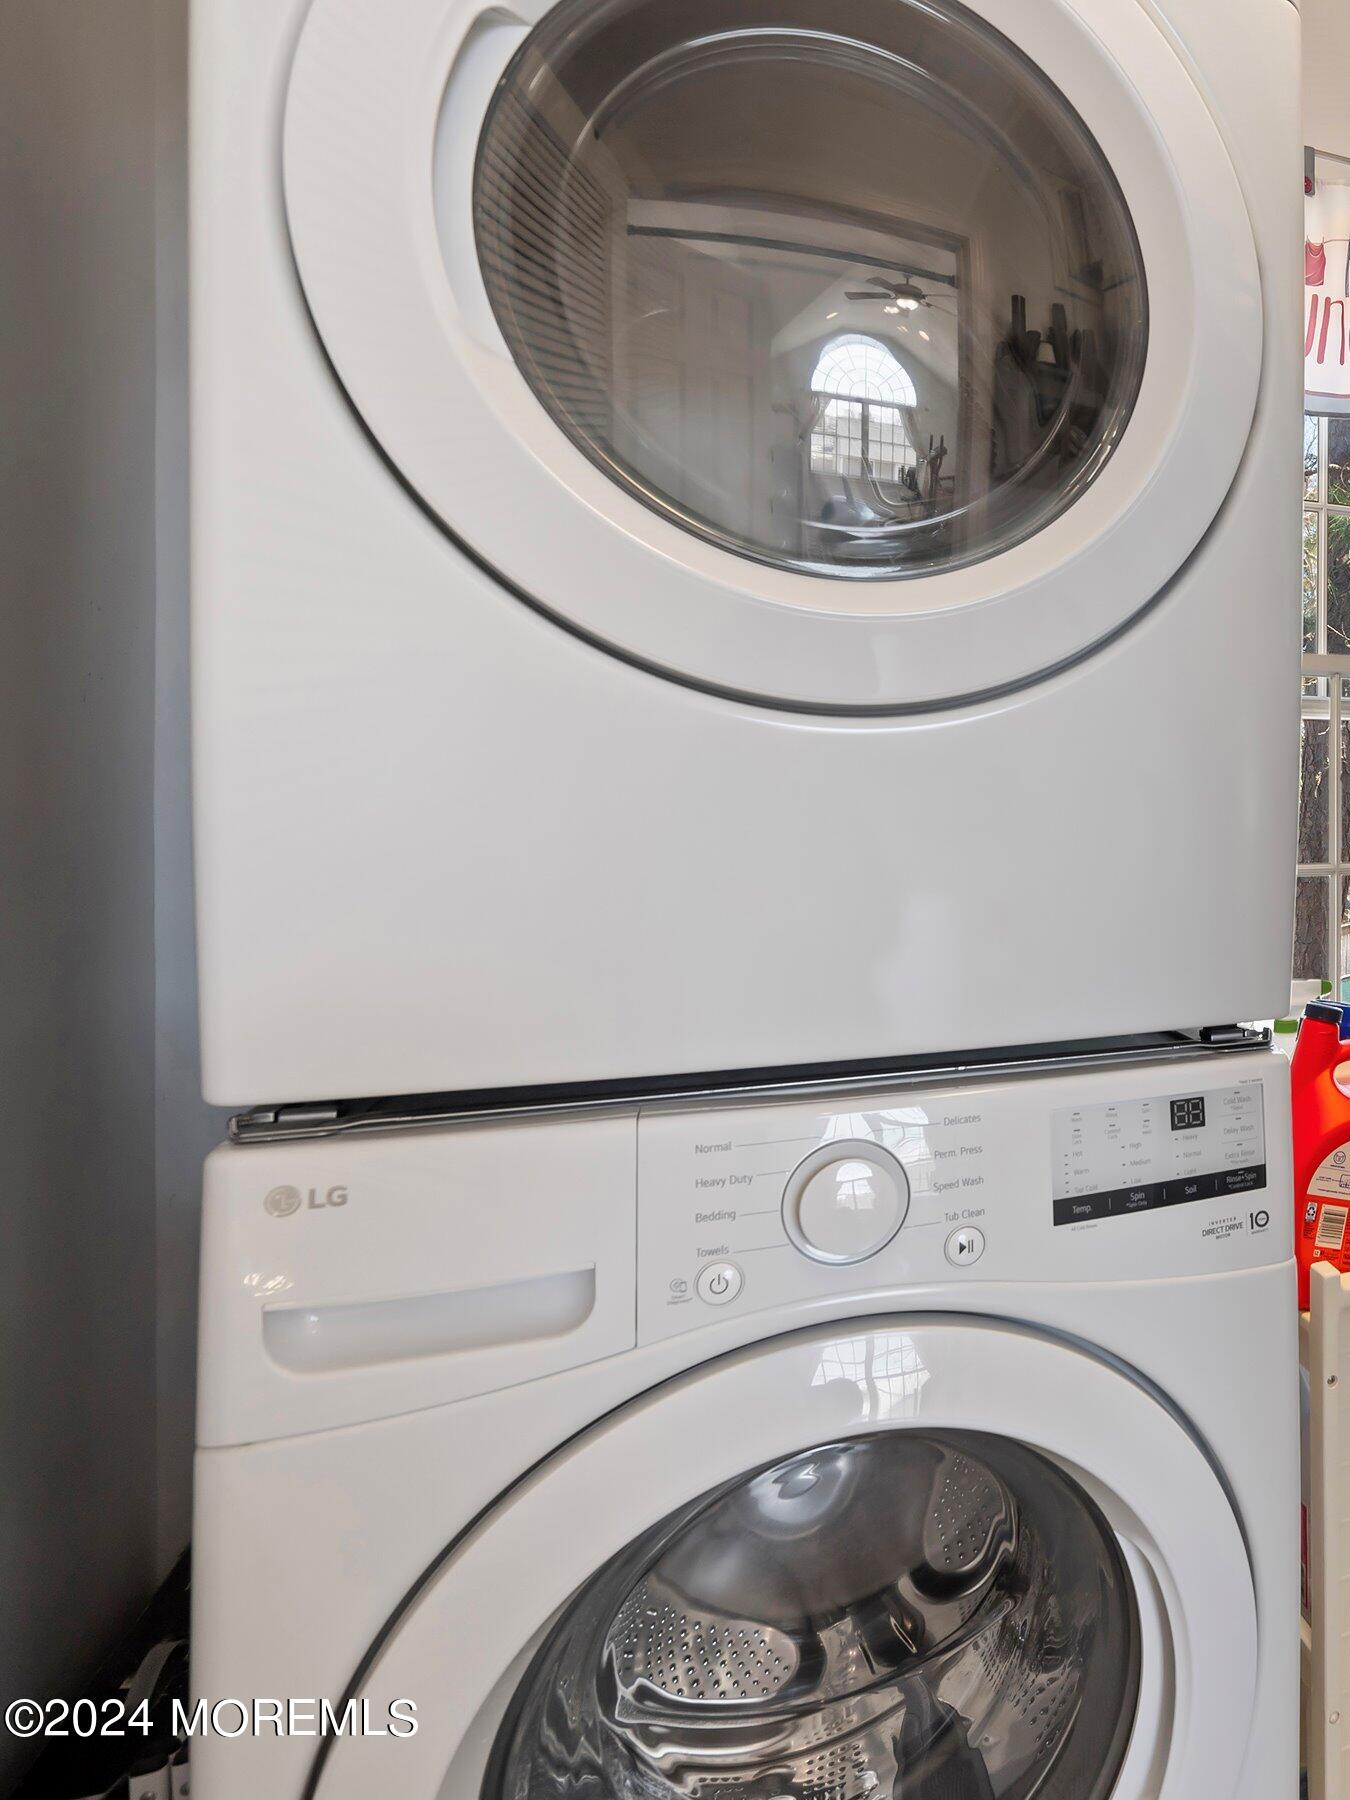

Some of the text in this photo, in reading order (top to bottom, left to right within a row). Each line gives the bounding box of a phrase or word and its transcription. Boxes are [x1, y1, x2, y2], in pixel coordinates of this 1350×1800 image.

[943, 1114, 982, 1127] Delicates
[694, 1141, 732, 1155] Normal
[933, 1145, 983, 1160] Perm. Press
[695, 1173, 753, 1189] Heavy Duty
[933, 1176, 985, 1193] Speed Wash
[1184, 1184, 1198, 1195] Soil
[307, 1185, 349, 1210] LG
[1130, 1192, 1146, 1202] Spin
[695, 1210, 737, 1224] Bedding
[943, 1206, 985, 1222] Tub Clean
[1072, 1205, 1092, 1215] Temp.
[1249, 1210, 1269, 1230] 10
[1202, 1225, 1225, 1237] DIRECT
[1225, 1221, 1244, 1233] DRIVE
[695, 1244, 729, 1258] Towels
